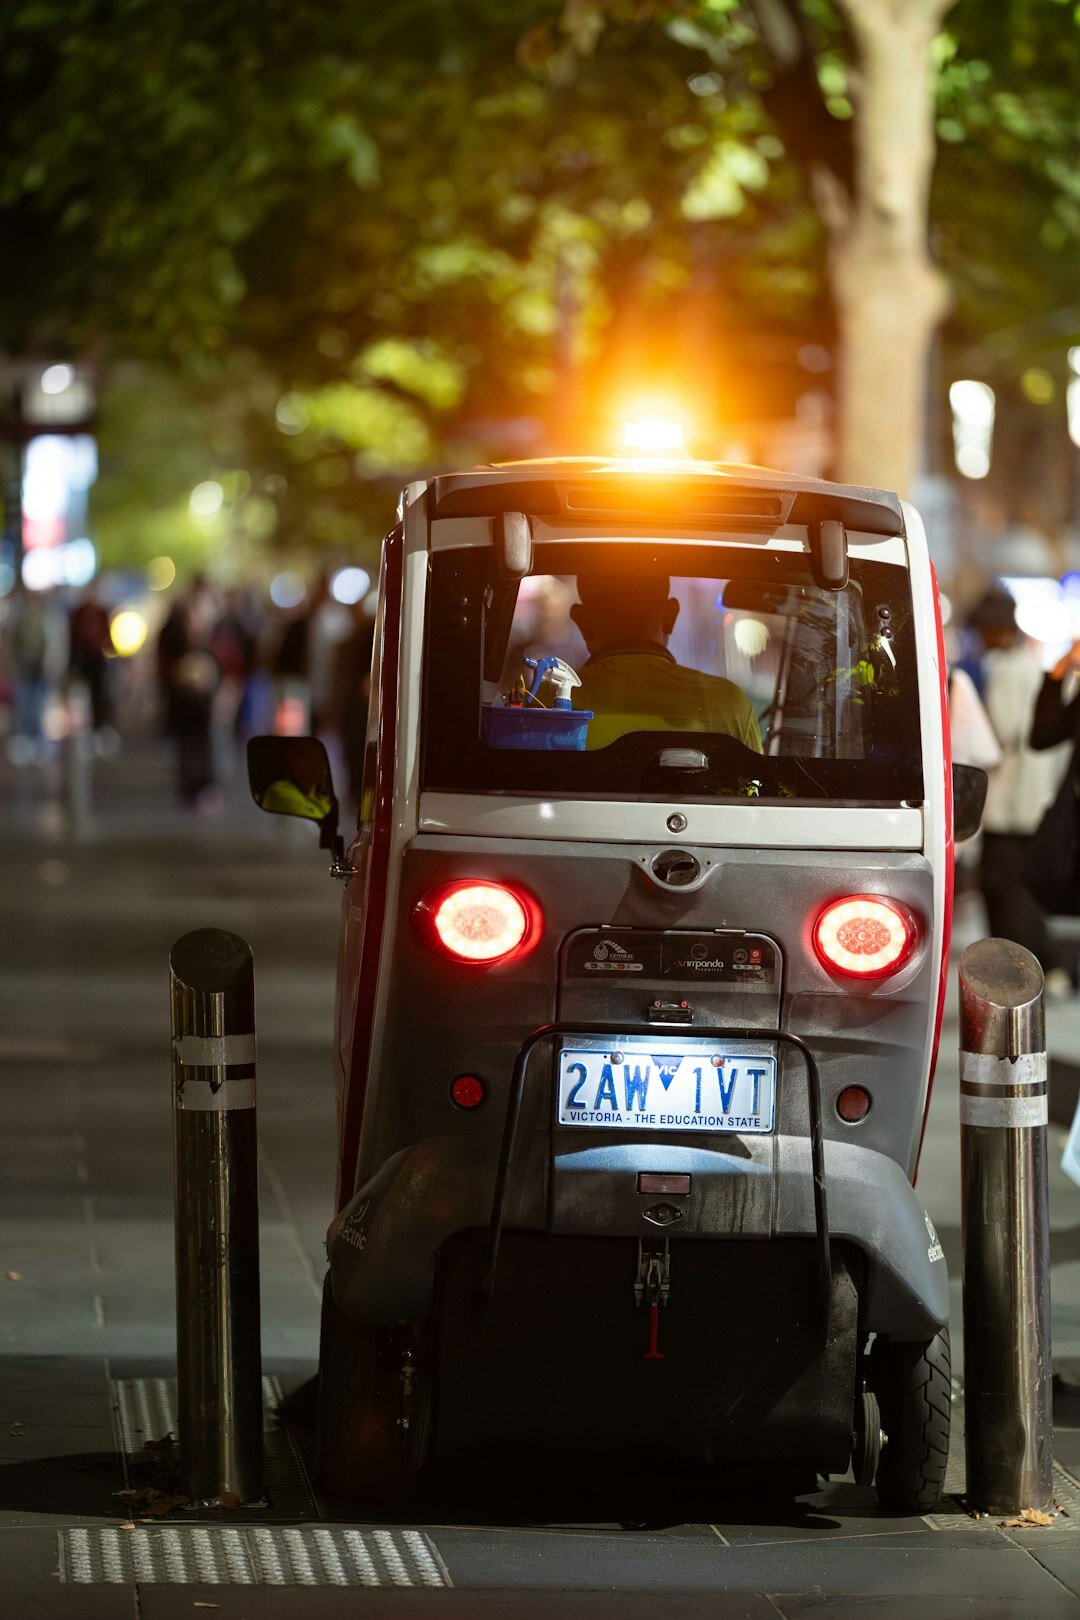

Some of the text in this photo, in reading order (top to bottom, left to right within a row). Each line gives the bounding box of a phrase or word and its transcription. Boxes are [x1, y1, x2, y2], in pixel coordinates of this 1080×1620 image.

[657, 1065, 677, 1076] VIC
[566, 1062, 766, 1114] 2AW 1VT
[569, 1111, 623, 1123] VICTORIA
[635, 1113, 656, 1124] THE
[660, 1114, 724, 1126] EDUCATION
[727, 1116, 761, 1127] STATE
